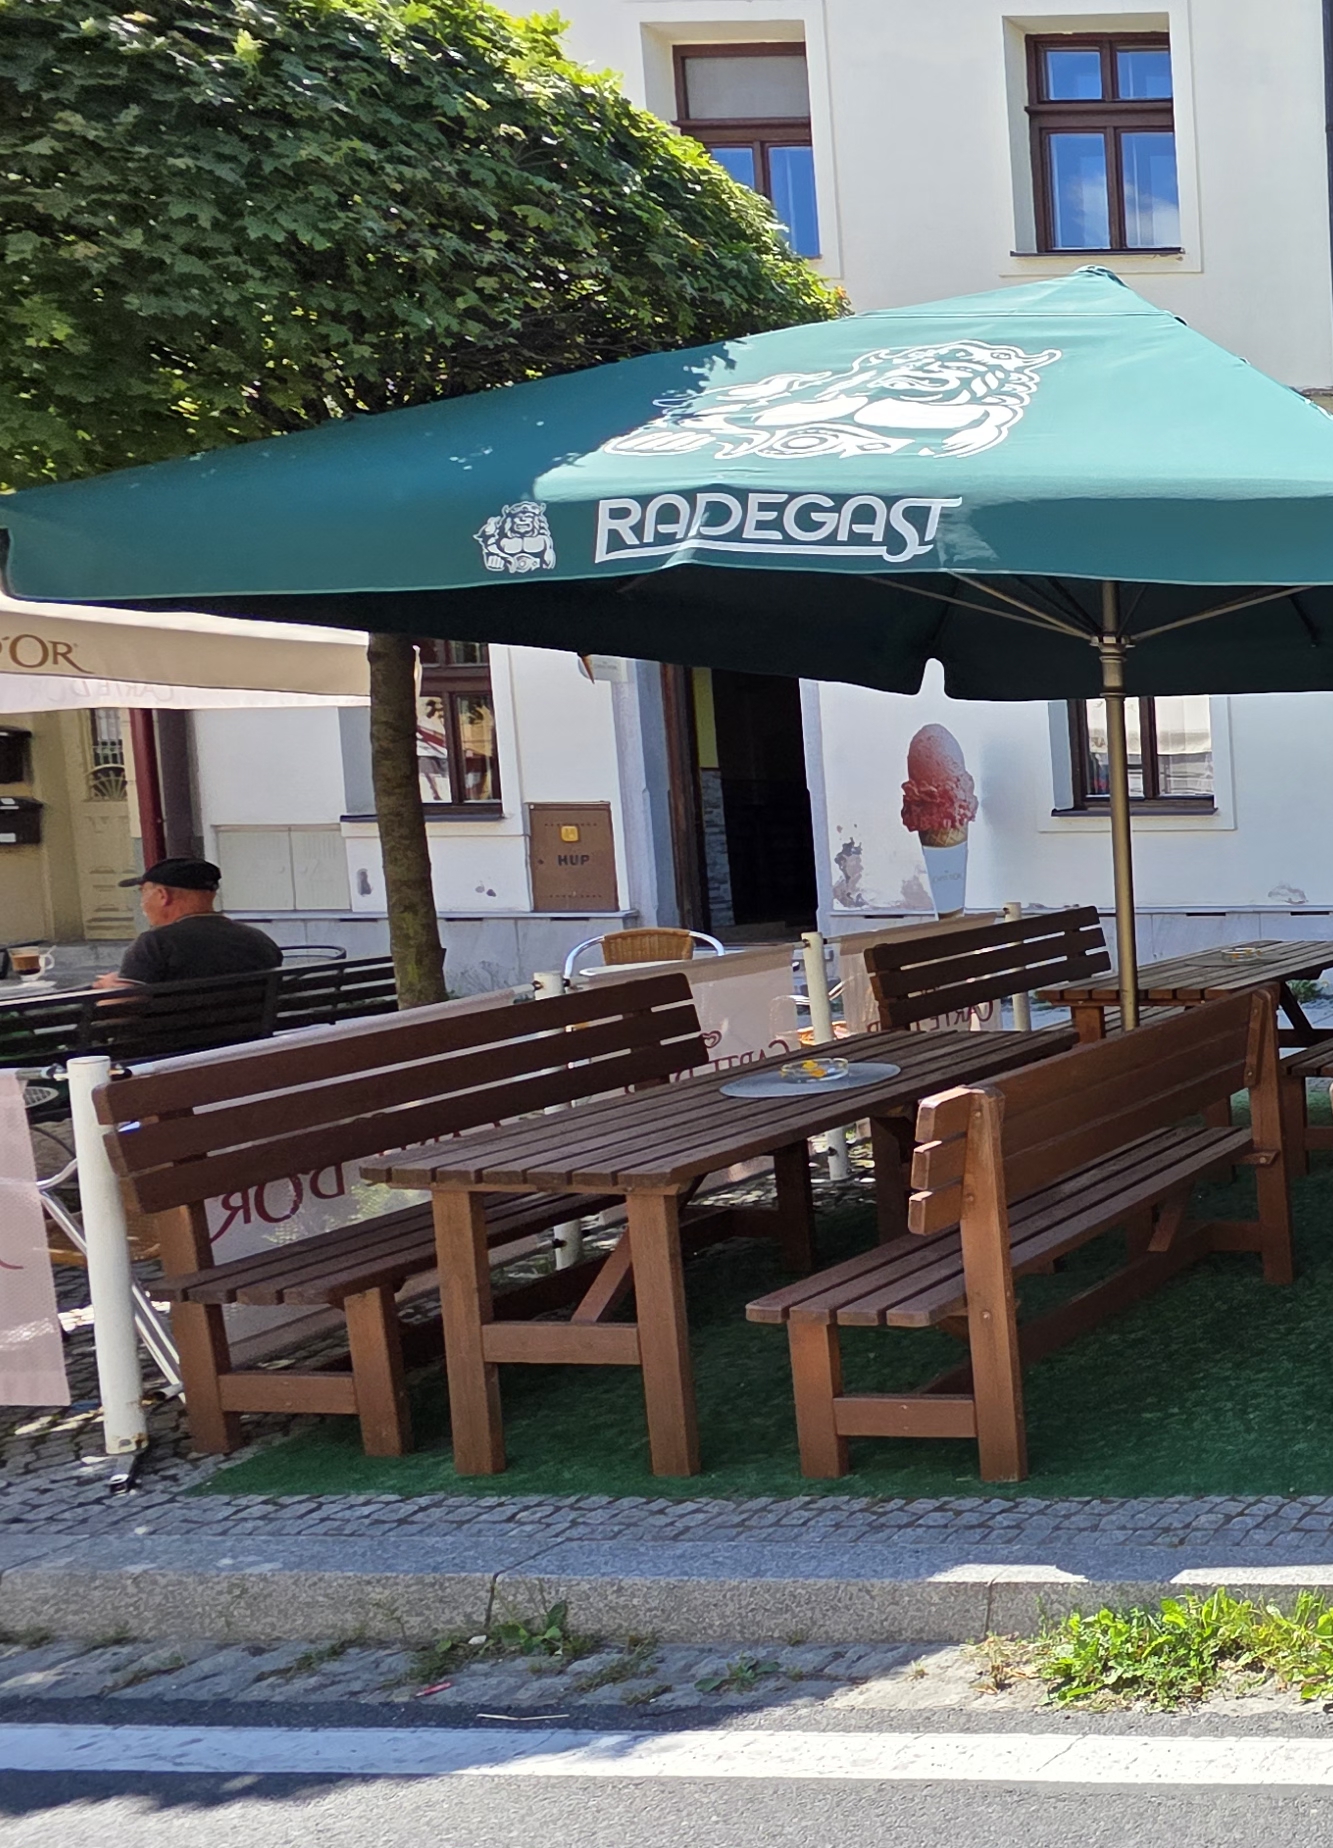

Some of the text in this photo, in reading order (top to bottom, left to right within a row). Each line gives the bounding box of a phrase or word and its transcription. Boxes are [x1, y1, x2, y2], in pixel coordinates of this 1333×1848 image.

[595, 492, 963, 563] RADEGAST
[0, 634, 95, 675] 'OR
[558, 855, 590, 866] HUP
